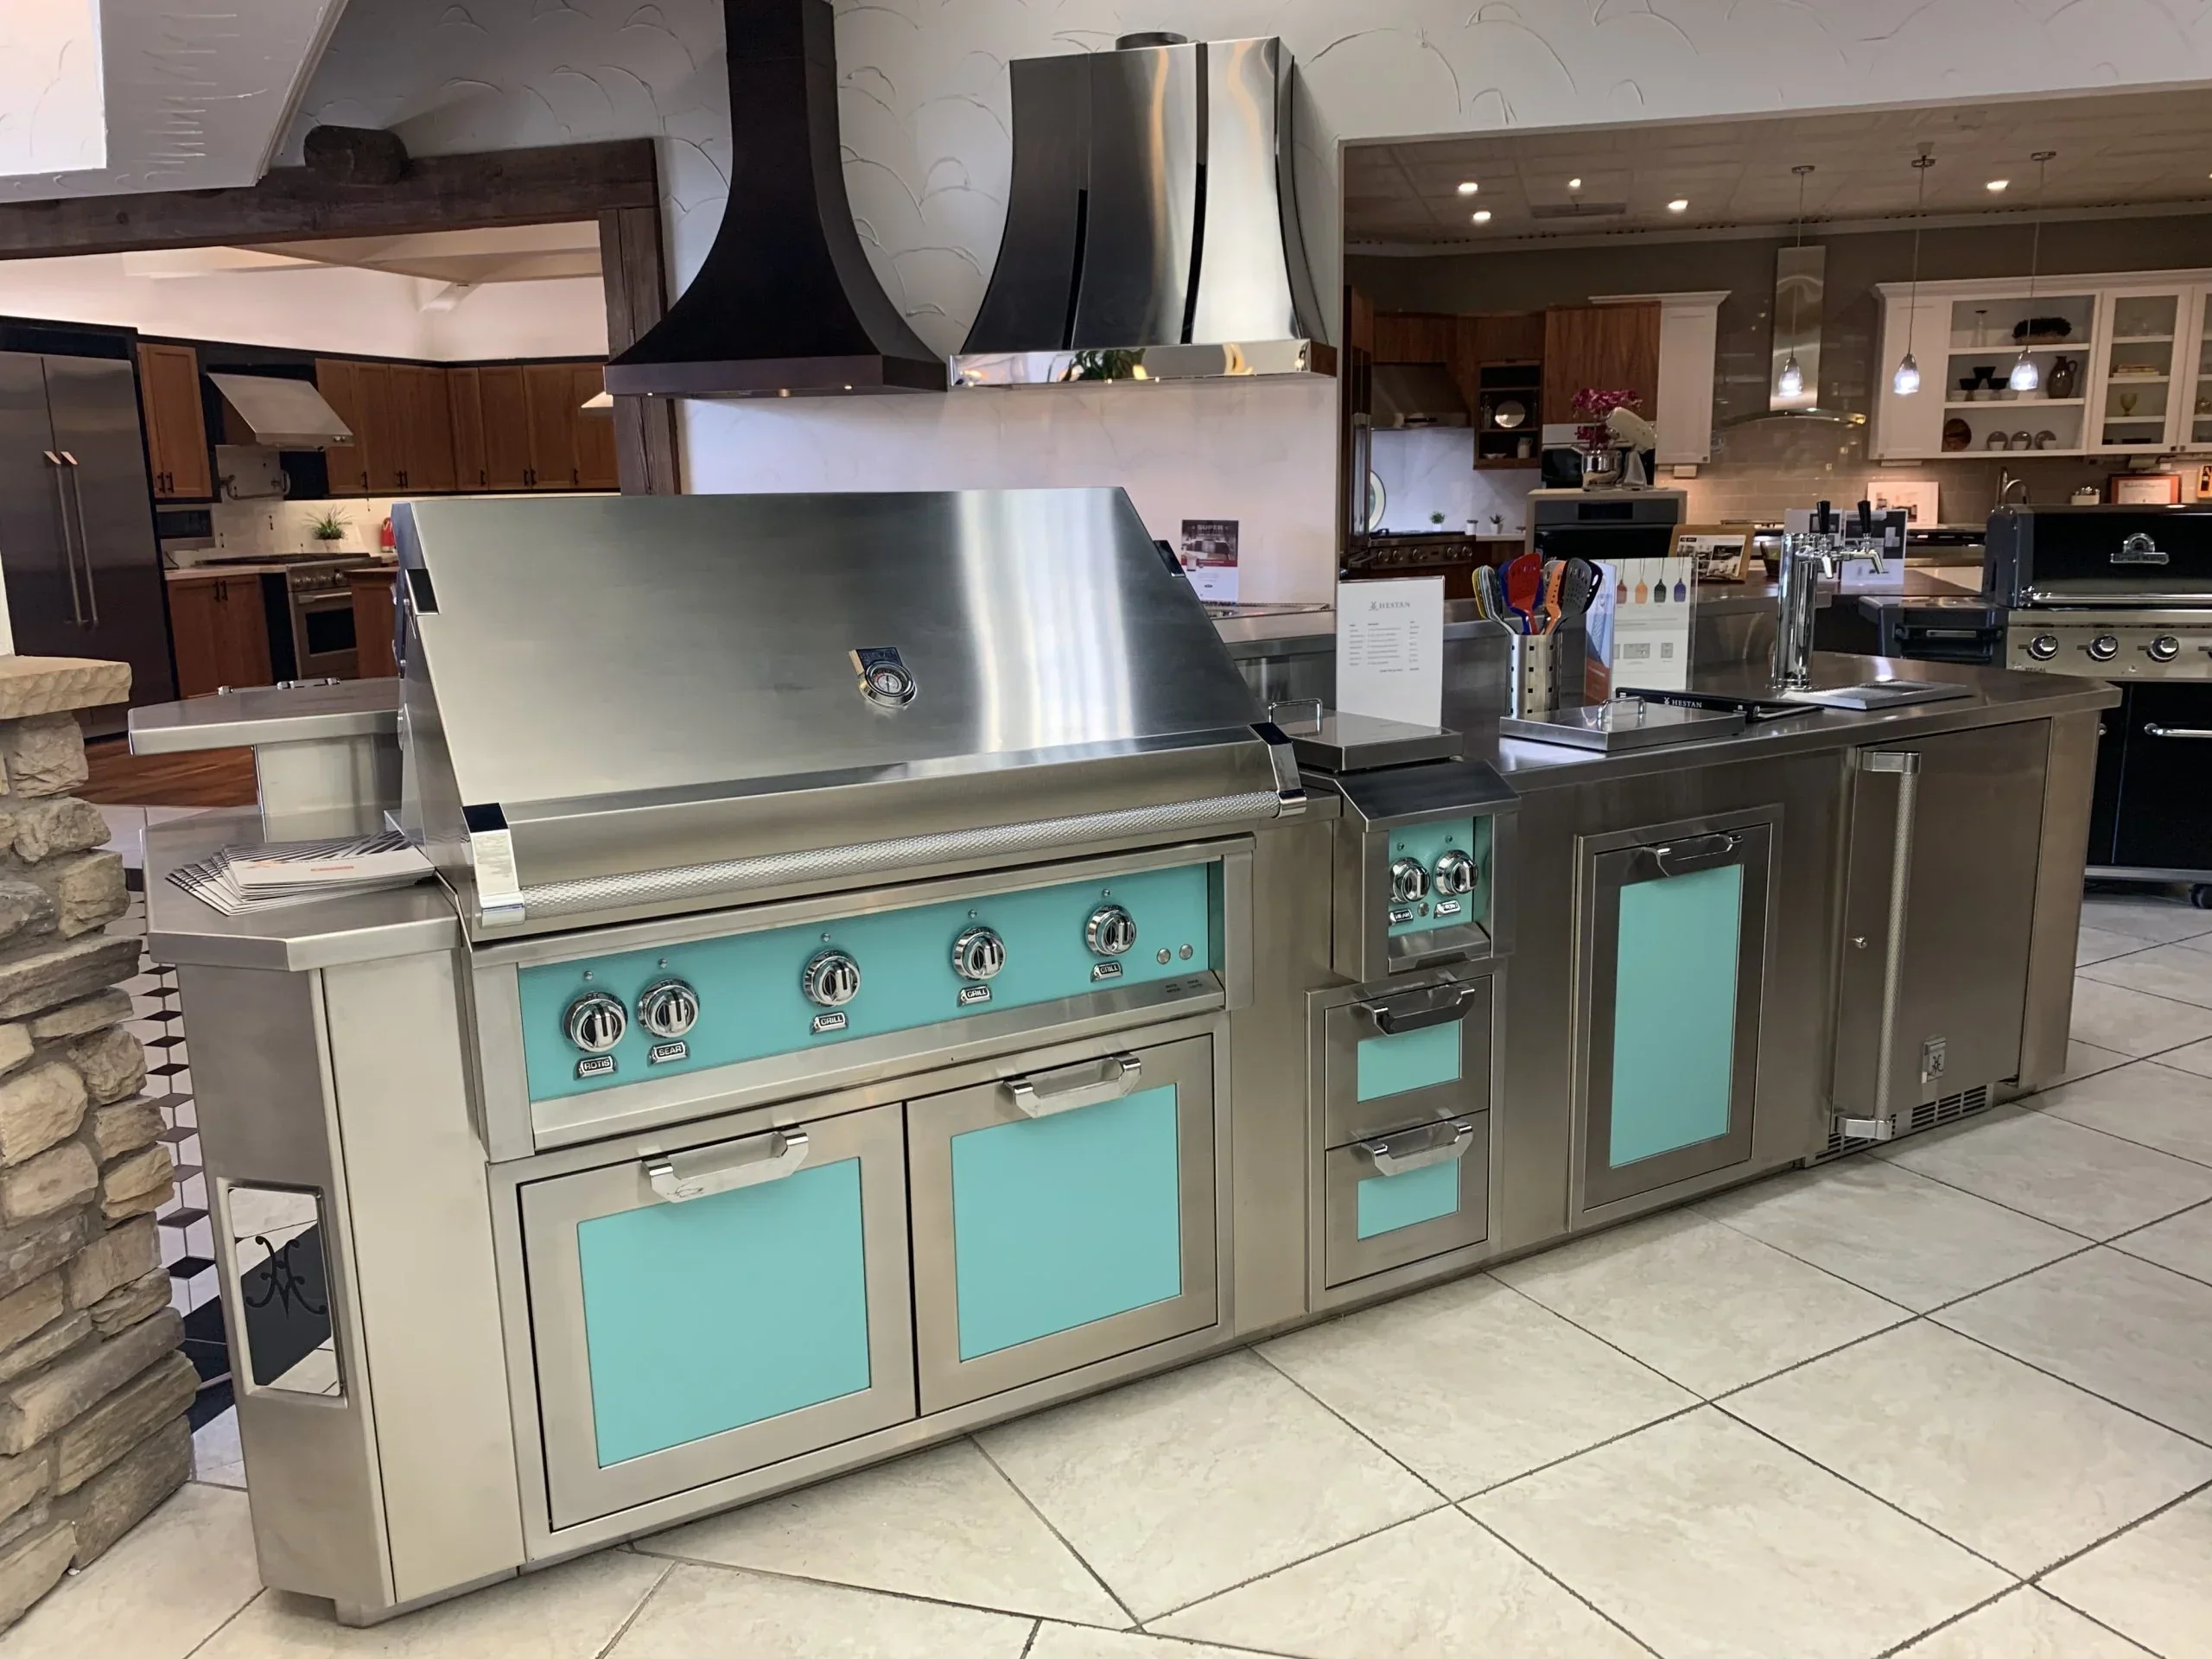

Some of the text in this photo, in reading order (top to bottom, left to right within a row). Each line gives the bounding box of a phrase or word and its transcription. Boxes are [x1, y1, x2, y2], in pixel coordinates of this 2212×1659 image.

[1672, 699, 1702, 709] HESTAN
[1100, 964, 1119, 974] GRILL
[967, 988, 987, 998] GRILL
[820, 1015, 843, 1026] GRILL
[658, 1045, 682, 1056] SEAR
[584, 1058, 610, 1071] ROTIS
